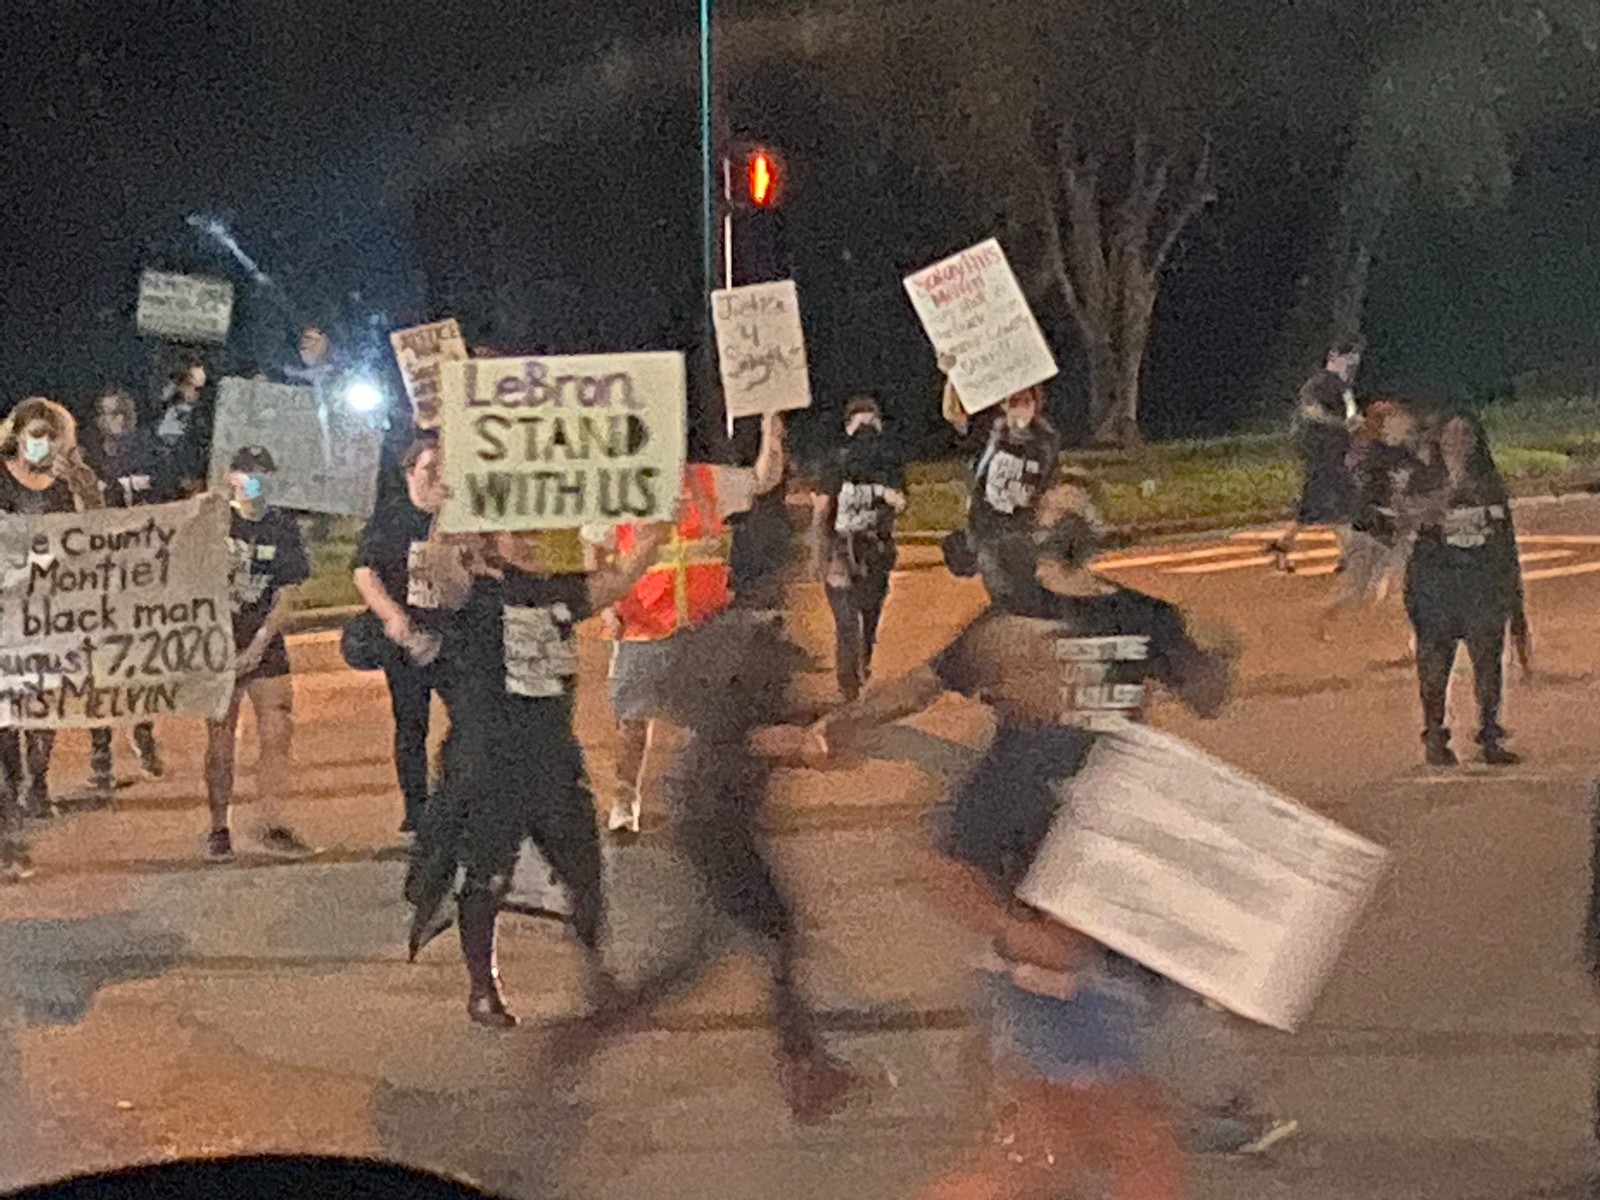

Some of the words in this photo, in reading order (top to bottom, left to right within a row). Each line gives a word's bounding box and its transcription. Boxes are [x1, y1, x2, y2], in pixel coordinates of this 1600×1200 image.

[464, 360, 647, 409] LeBron
[474, 413, 650, 462] STAND
[464, 468, 587, 518] WITH
[598, 466, 660, 517] US
[60, 517, 177, 557] County
[22, 594, 119, 637] black
[133, 597, 217, 629] man
[57, 674, 180, 719] MELVIN
